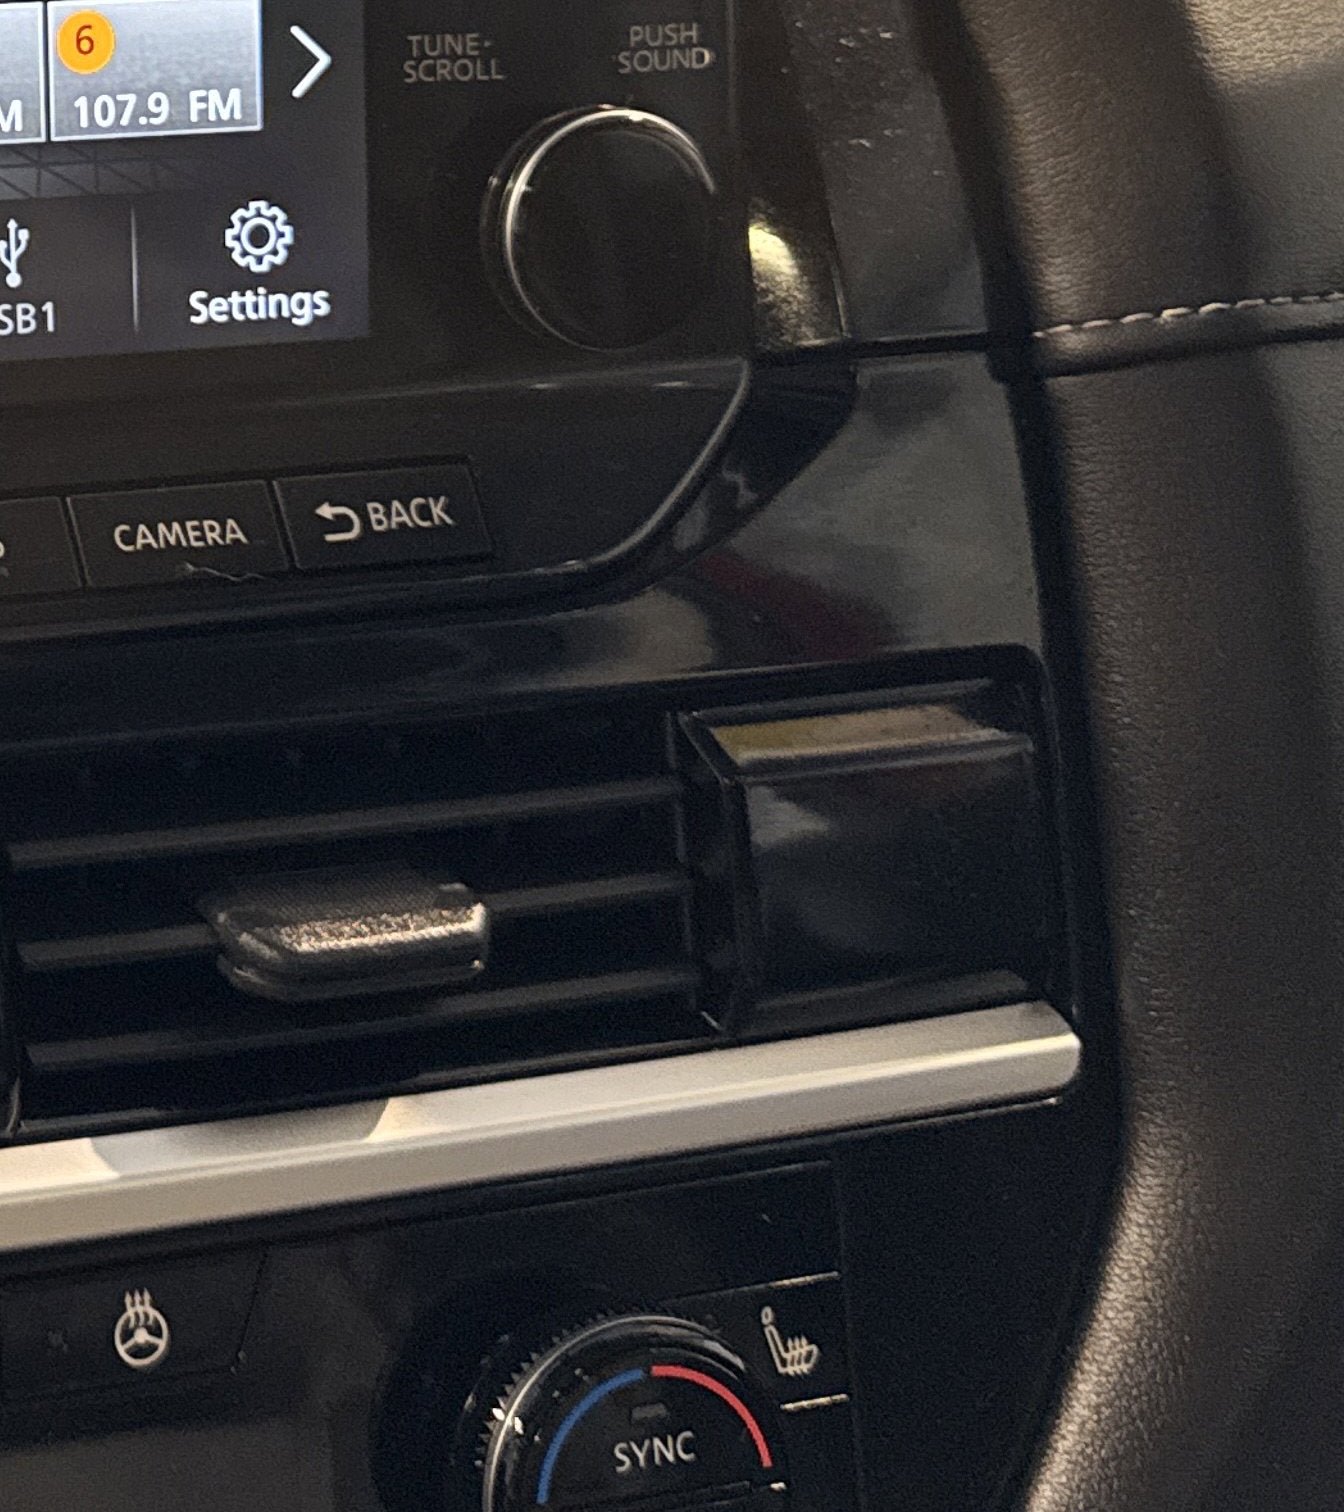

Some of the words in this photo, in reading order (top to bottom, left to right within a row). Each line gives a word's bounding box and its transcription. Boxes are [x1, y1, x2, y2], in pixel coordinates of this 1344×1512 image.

[75, 24, 95, 56] 6
[629, 22, 699, 46] PUSH
[403, 58, 505, 84] SCROLL
[618, 46, 711, 74] SOUND
[73, 91, 170, 128] 107.9
[189, 87, 242, 123] FM
[189, 286, 331, 326] Settings
[366, 495, 454, 532] BACK
[113, 518, 248, 552] CAMERA
[613, 1430, 695, 1473] SYNC
